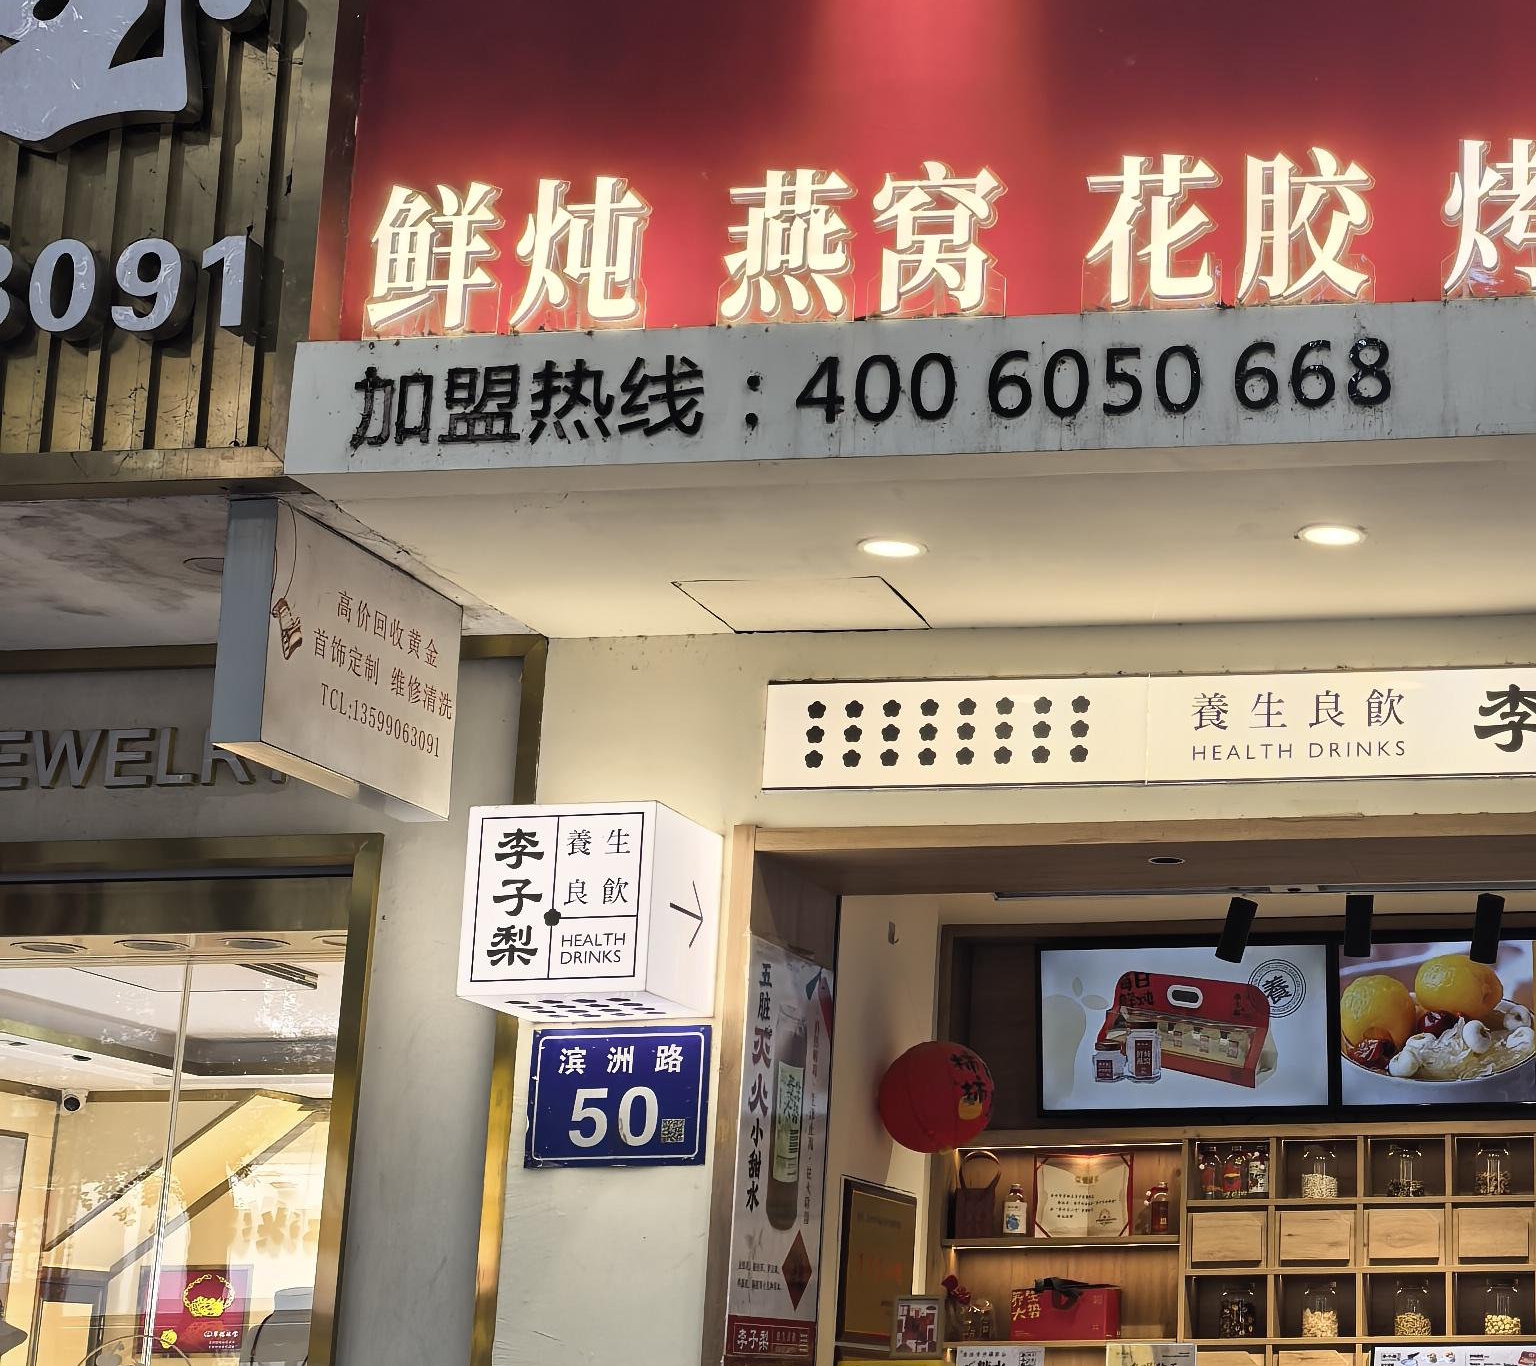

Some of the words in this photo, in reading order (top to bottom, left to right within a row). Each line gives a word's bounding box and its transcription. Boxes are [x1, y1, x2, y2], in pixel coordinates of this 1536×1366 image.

[367, 175, 652, 333] 鲜炖
[718, 160, 1006, 325] 燕窝
[1086, 147, 1372, 311] 花胶
[0, 237, 248, 335] 091
[796, 352, 958, 425] 400
[987, 345, 1202, 420] 6050
[1233, 337, 1392, 410] 668
[337, 591, 440, 668] 高价回收黄金
[313, 628, 380, 686] 首饰定制
[390, 666, 452, 720] 维修清洗
[1191, 687, 1407, 732] 養生良飲
[0, 727, 290, 789] EWELR
[1191, 743, 1294, 761] HEALTH
[1308, 740, 1407, 759] DRINKS
[567, 828, 631, 856] 養生
[487, 827, 544, 966] 李子梨
[563, 877, 628, 906] 良飲
[560, 950, 621, 965] DRINKS
[561, 933, 626, 947] HEALTH
[558, 1043, 684, 1075] 滨洲路
[568, 1086, 659, 1147] 50
[736, 1328, 769, 1351] 李子梨
